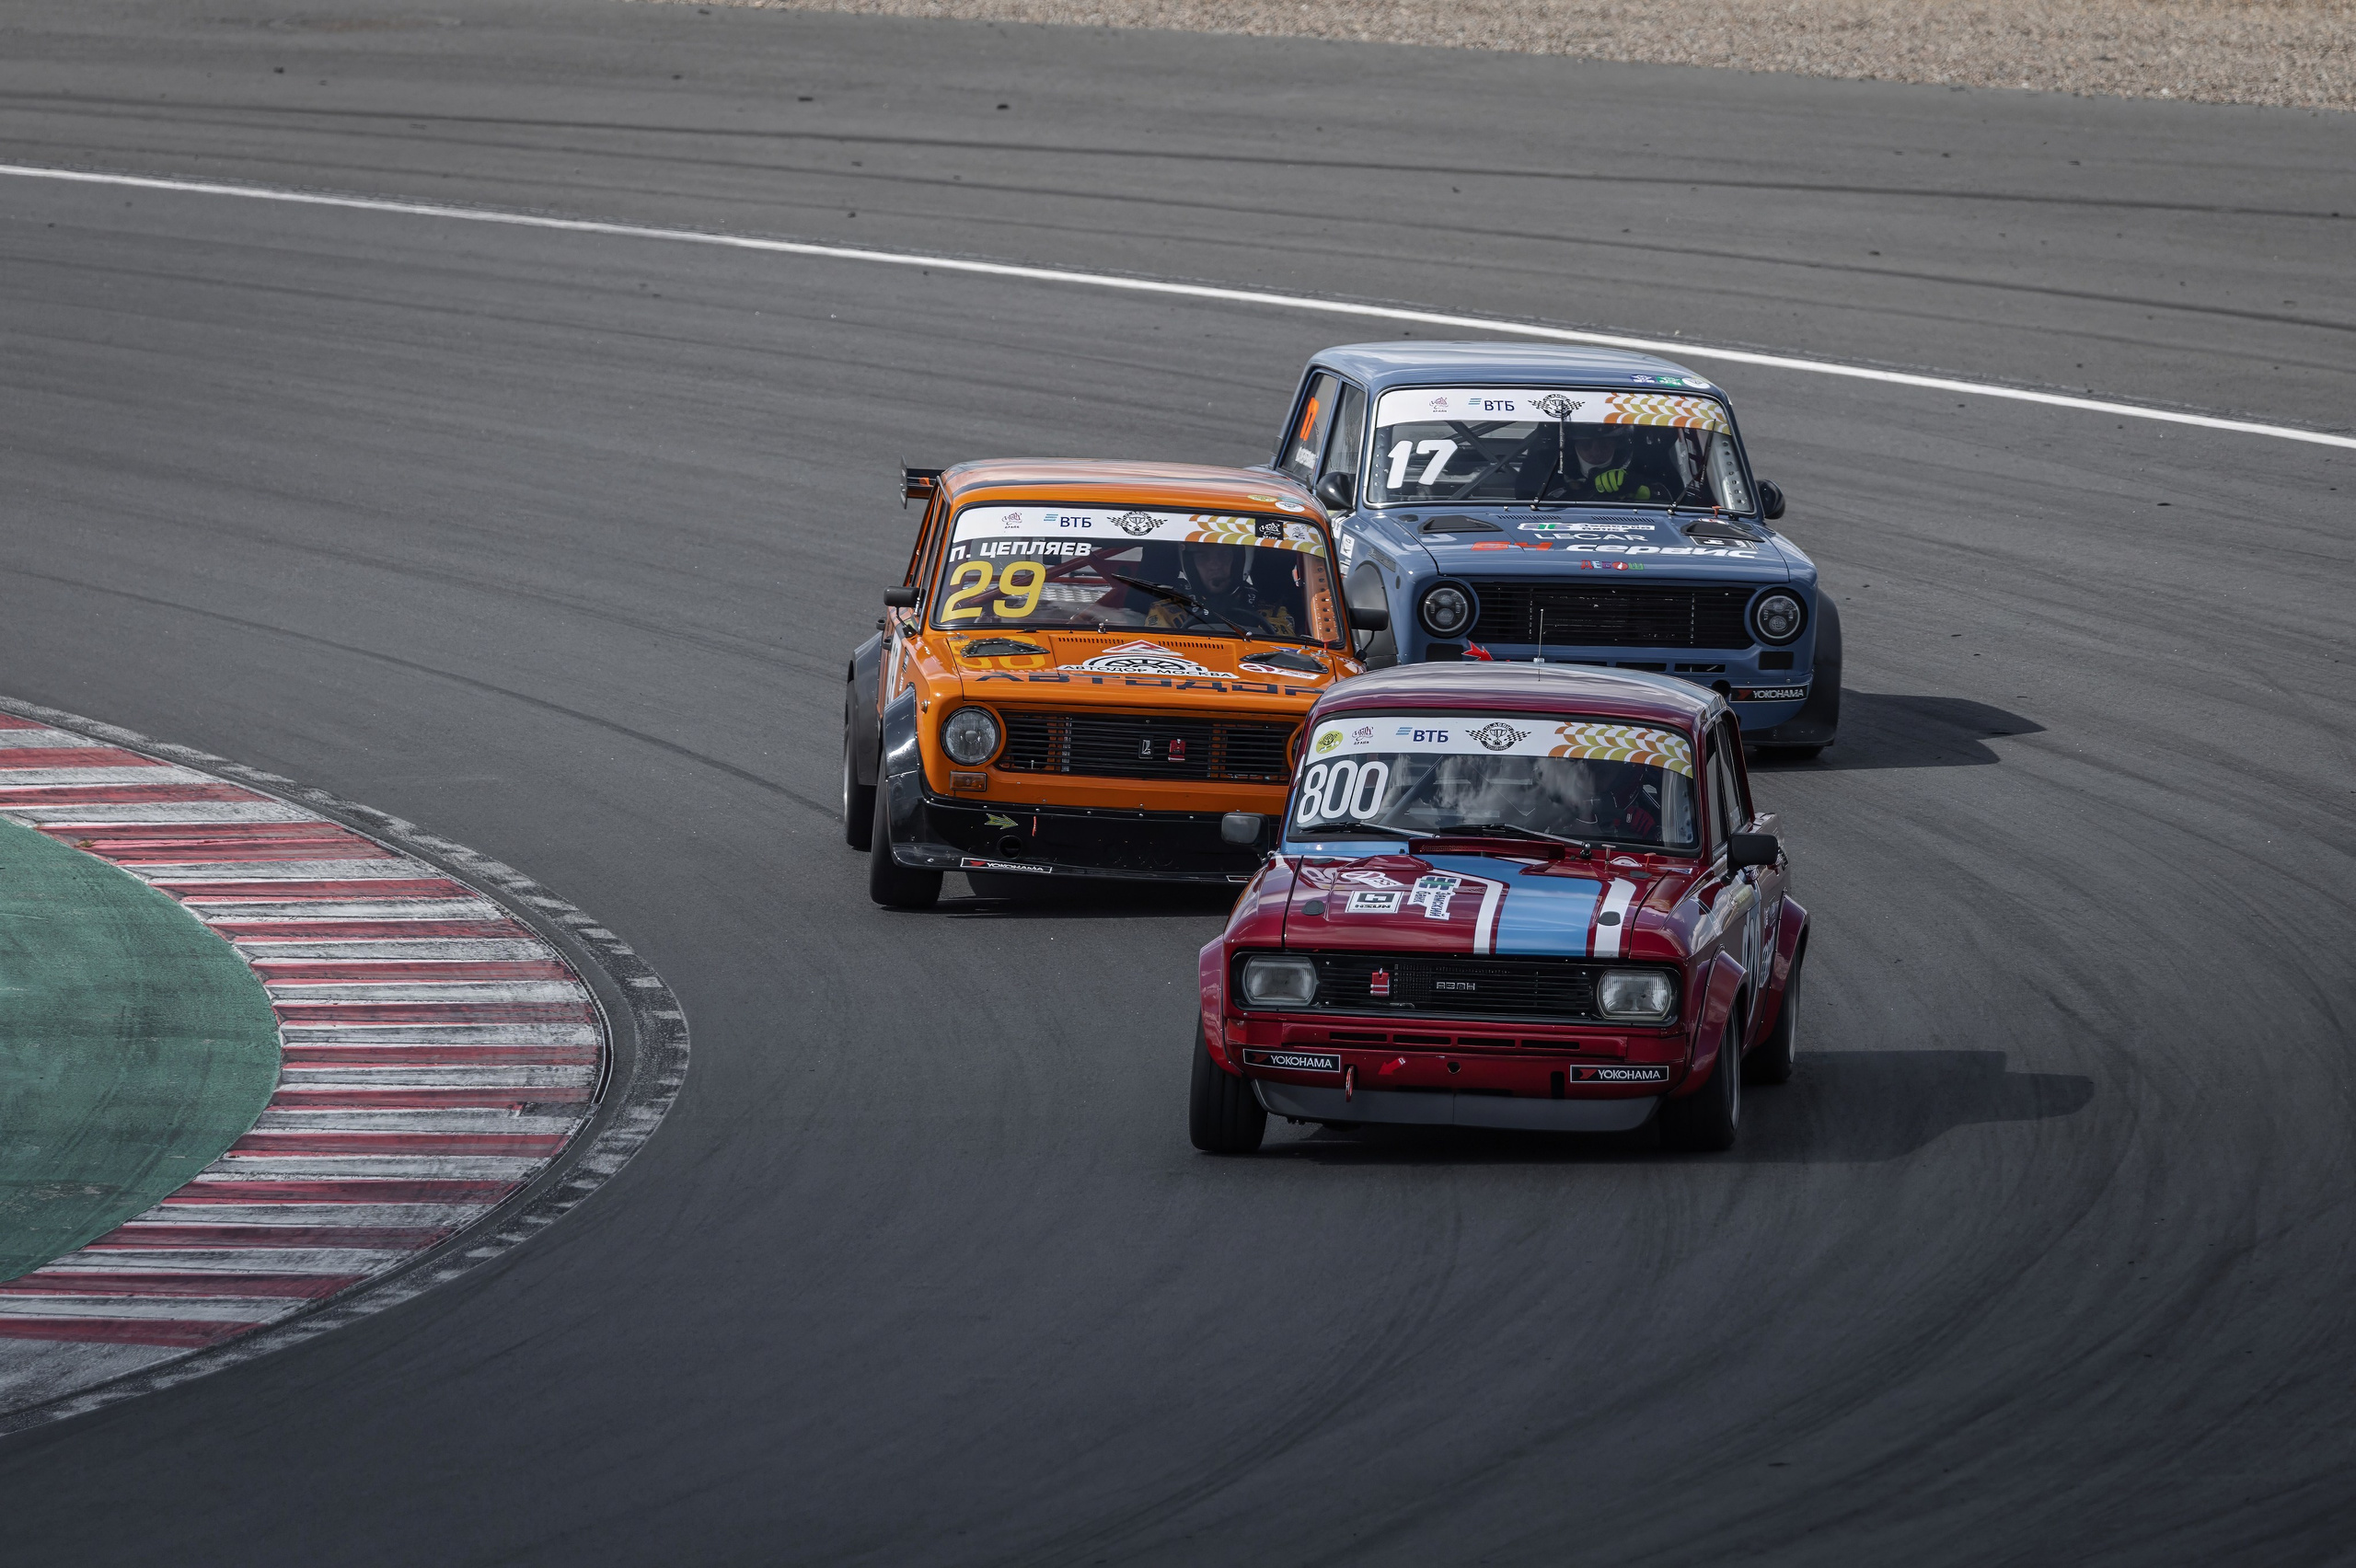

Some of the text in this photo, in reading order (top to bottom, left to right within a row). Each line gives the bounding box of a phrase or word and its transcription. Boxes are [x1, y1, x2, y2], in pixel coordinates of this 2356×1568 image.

[1484, 399, 1516, 411] ВТБ
[1386, 439, 1459, 489] 17
[1059, 516, 1092, 528] ВТБ
[1534, 533, 1648, 542] LECAR
[949, 541, 1093, 563] П. ЦЕПЛЯЕВ
[940, 560, 1047, 624] 29
[1063, 665, 1232, 678] АВТОДОР МОСКВА
[1752, 688, 1804, 698] YOKOHAMA
[1413, 730, 1449, 743] ВТБ
[1297, 760, 1389, 824] 800
[986, 862, 1044, 871] YOKOHAMA
[1270, 1055, 1333, 1068] YOKOHAMA
[1598, 1069, 1661, 1079] YOKOHAMA
